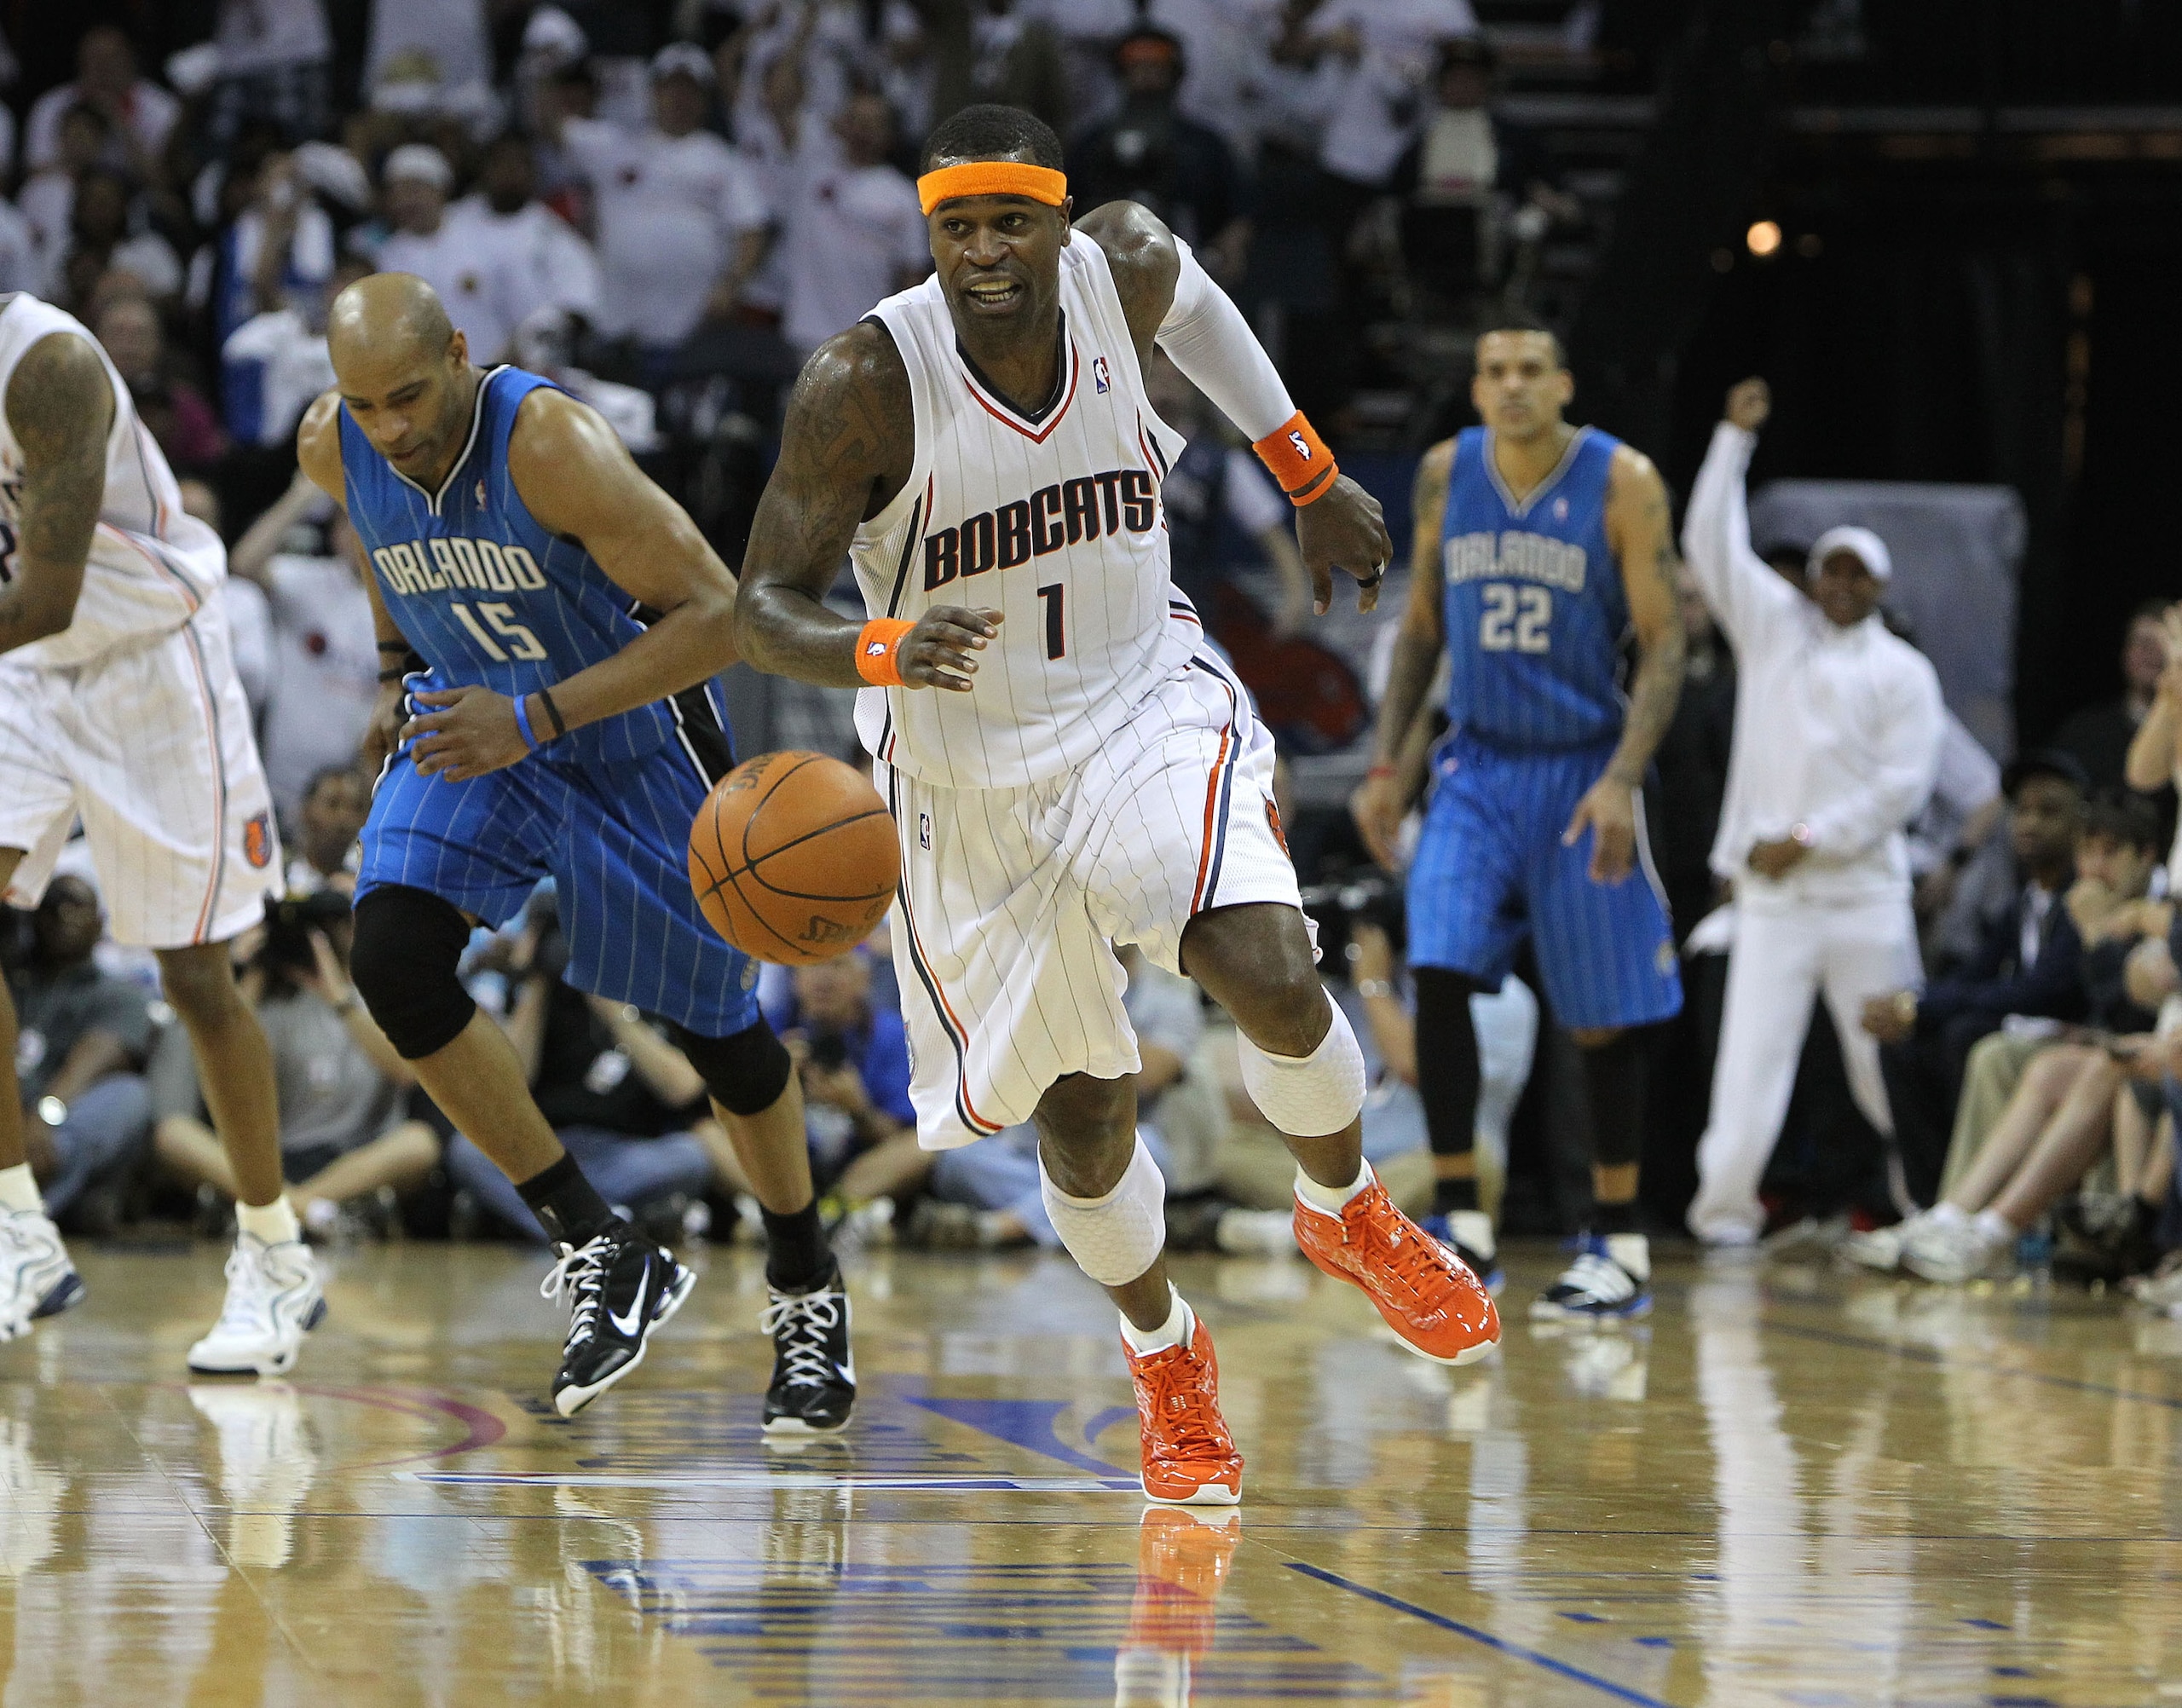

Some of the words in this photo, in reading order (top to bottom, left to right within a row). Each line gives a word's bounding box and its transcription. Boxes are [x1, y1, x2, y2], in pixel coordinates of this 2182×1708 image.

[372, 536, 548, 596] ORLANDO
[924, 470, 1155, 591] BOBCATS
[450, 600, 548, 662] 15
[1036, 582, 1065, 661] 1
[1479, 582, 1552, 653] 22
